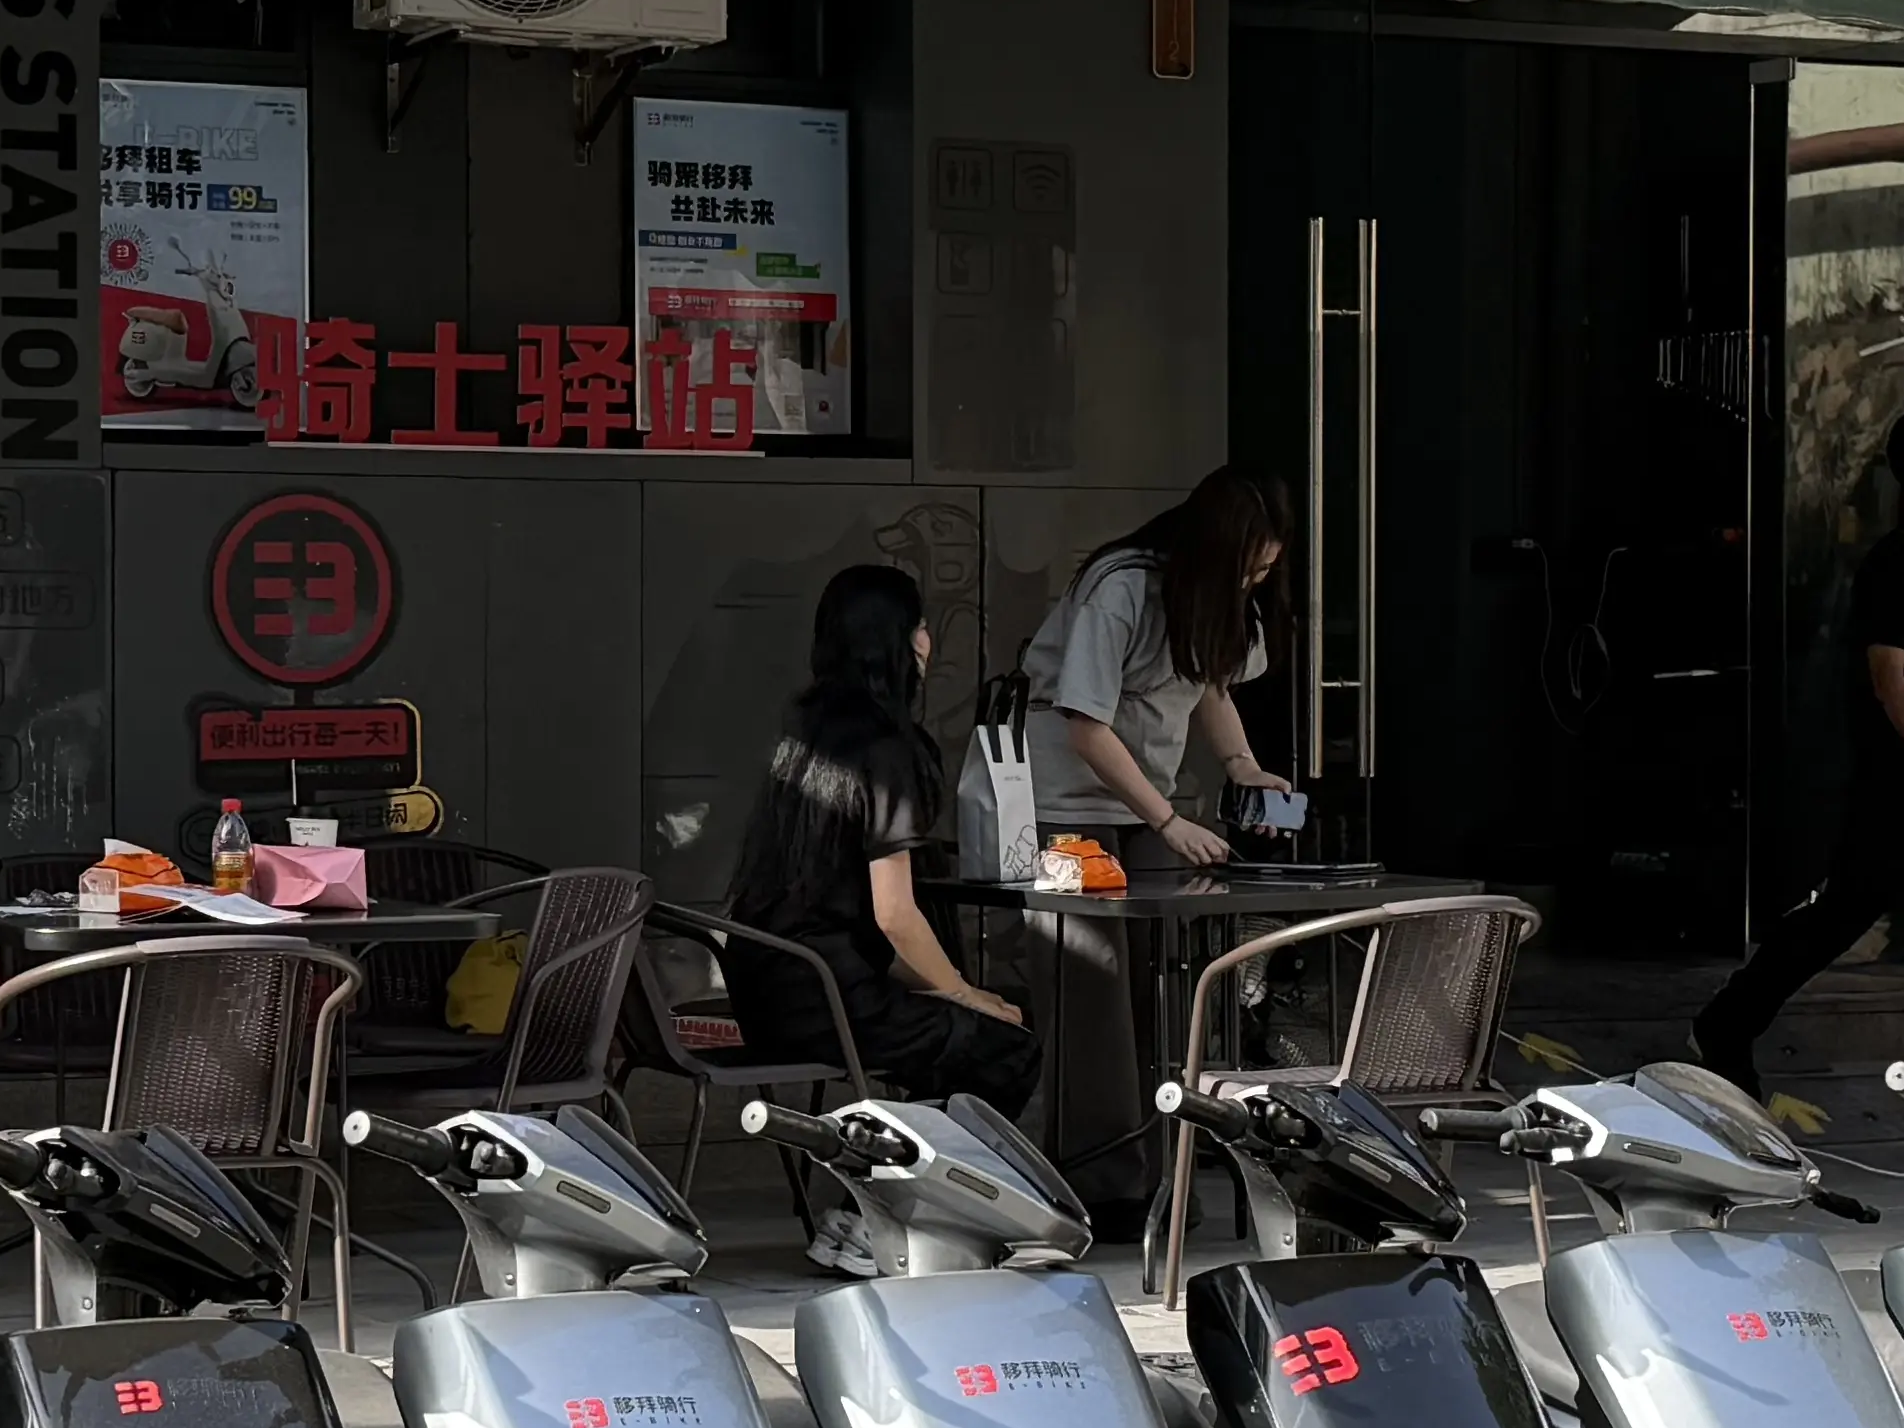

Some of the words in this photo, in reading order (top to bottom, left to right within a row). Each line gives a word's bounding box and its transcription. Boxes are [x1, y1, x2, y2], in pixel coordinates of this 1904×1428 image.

[228, 187, 258, 209] 99
[671, 195, 774, 225] 共赴未来
[0, 45, 78, 459] STATION
[258, 317, 756, 450] 骑士驿站
[209, 721, 399, 749] 便利出行每一天！
[1001, 1361, 1081, 1380] 移拜骑行
[613, 1396, 697, 1416] 移拜骑行
